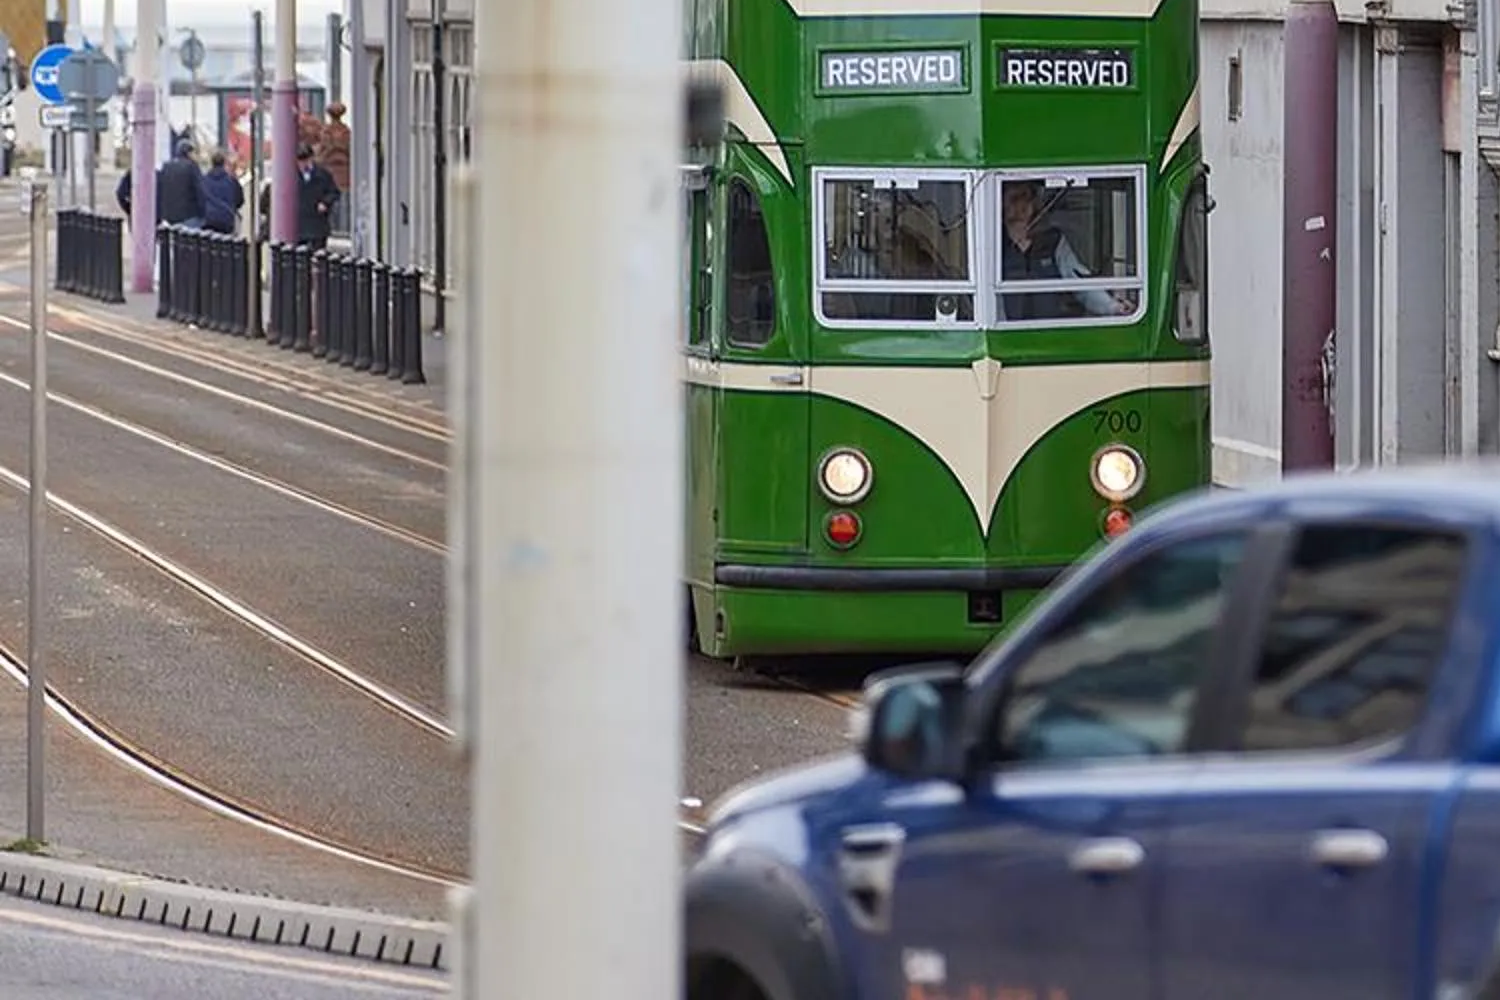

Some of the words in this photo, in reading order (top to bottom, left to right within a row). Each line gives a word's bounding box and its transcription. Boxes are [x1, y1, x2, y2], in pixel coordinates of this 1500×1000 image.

[827, 55, 956, 87] RESERVED
[1006, 59, 1128, 87] RESERVED
[1091, 409, 1142, 434] 700
